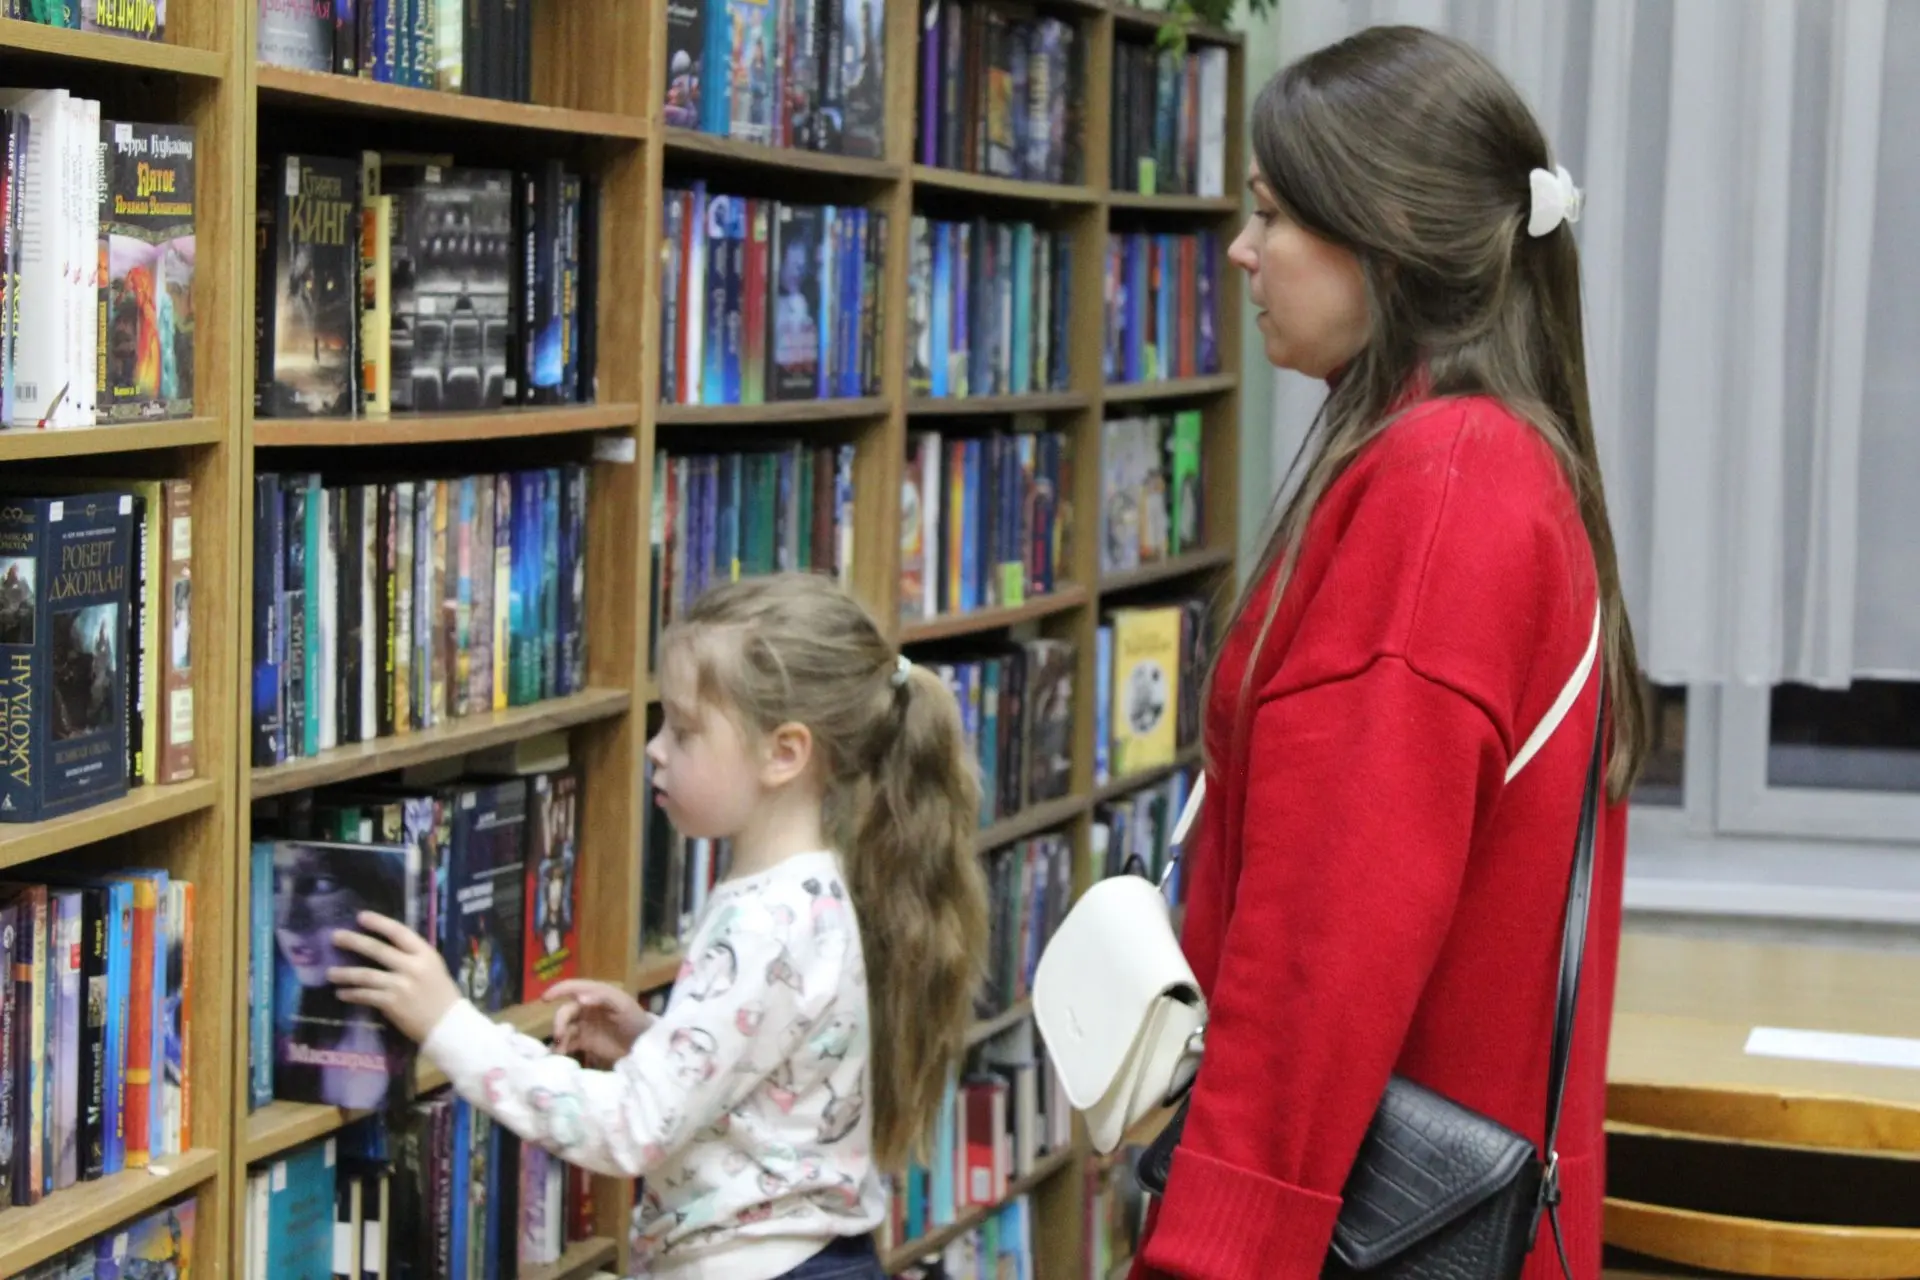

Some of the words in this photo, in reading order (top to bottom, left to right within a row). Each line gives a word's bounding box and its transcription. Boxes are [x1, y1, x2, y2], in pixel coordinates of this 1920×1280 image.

[288, 193, 353, 245] КИНГ
[62, 541, 116, 571] РОБЕРТ
[49, 566, 124, 602] ДЖОРДАН
[10, 654, 32, 787] ДЖОРДАН
